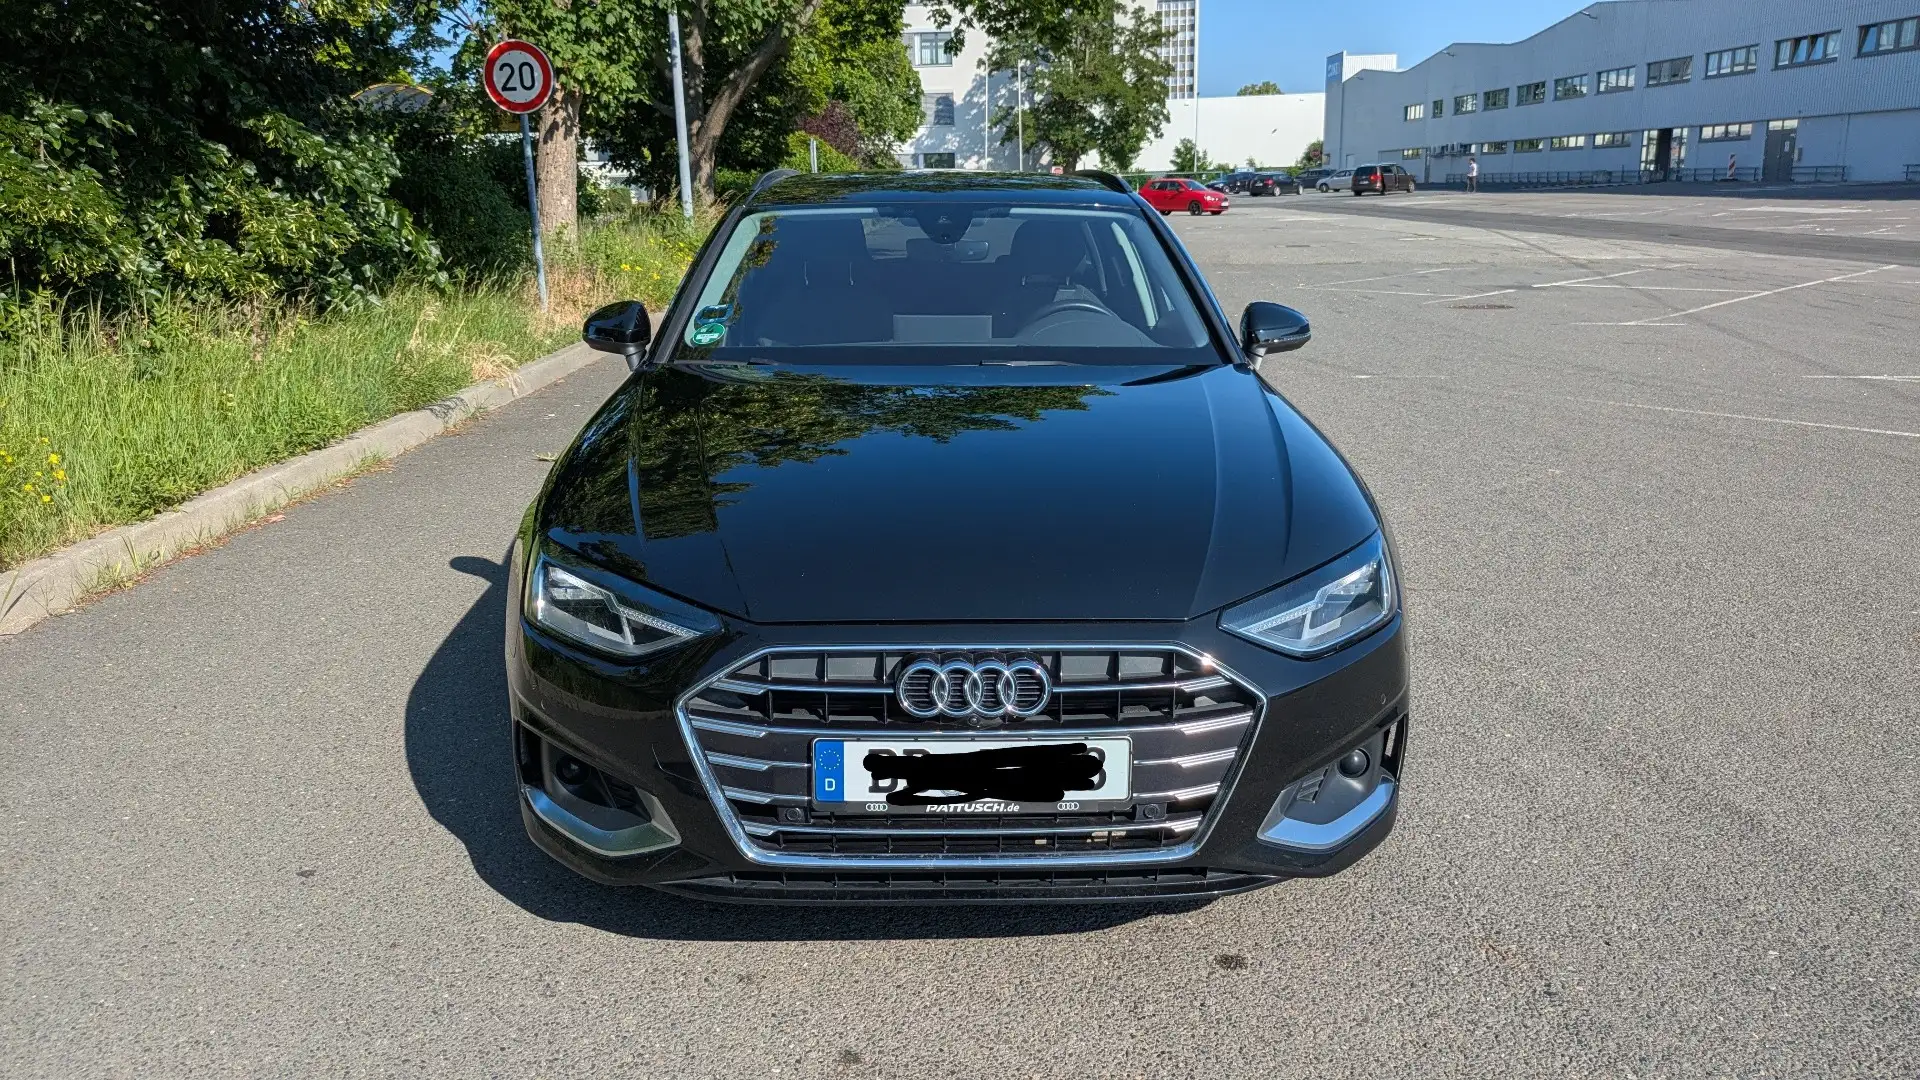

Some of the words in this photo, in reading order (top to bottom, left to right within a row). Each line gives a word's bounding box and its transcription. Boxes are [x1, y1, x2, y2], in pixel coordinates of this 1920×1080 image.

[499, 61, 536, 92] 20
[825, 778, 836, 791] D
[925, 802, 1020, 813] PATTUSCH.de
